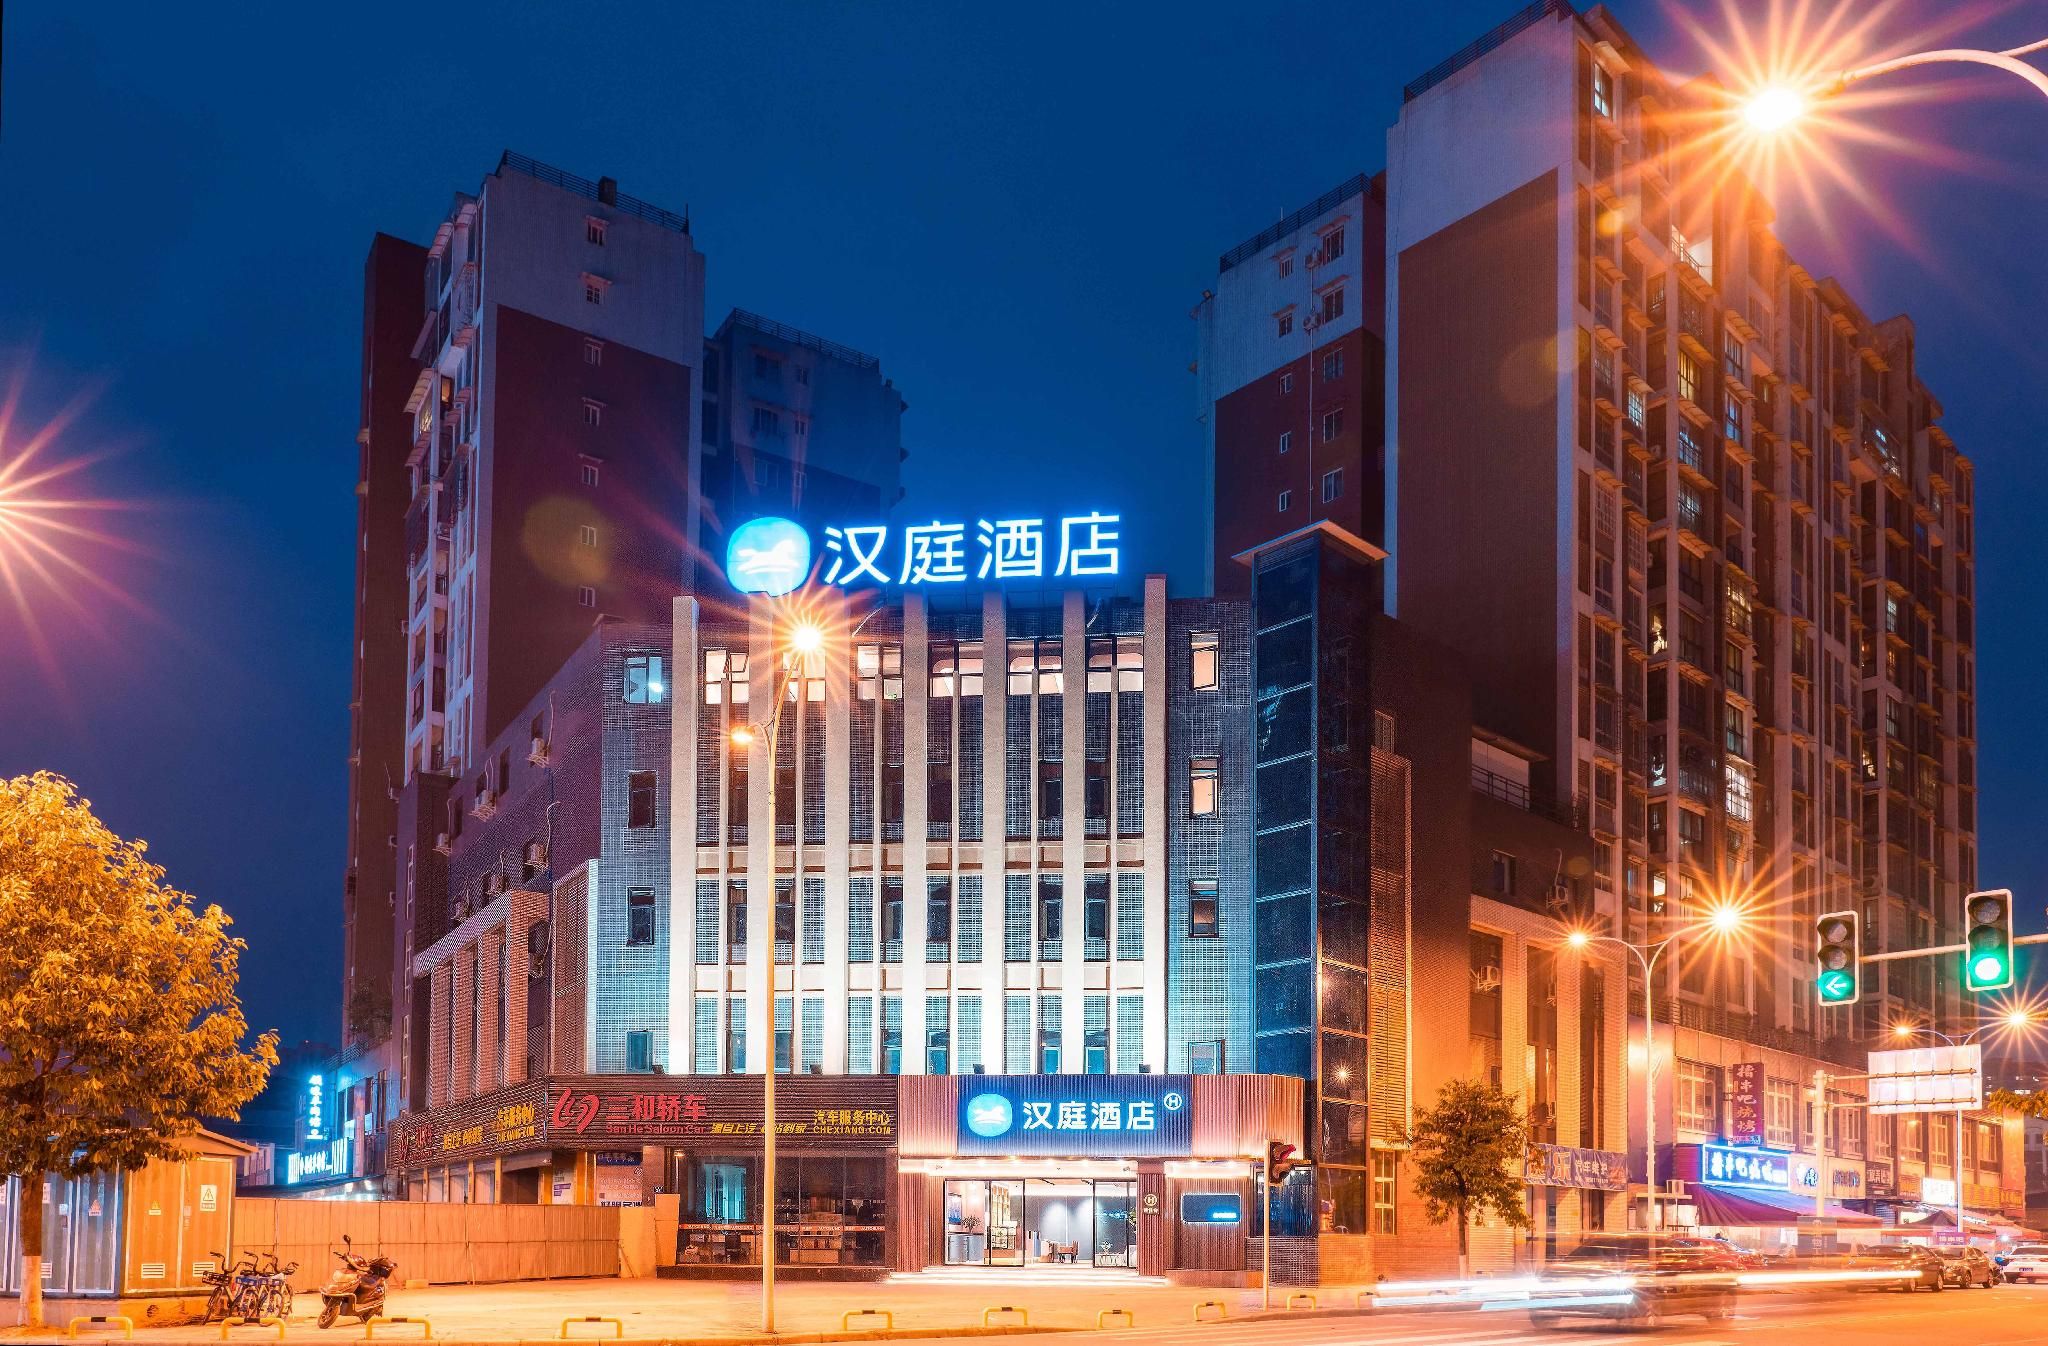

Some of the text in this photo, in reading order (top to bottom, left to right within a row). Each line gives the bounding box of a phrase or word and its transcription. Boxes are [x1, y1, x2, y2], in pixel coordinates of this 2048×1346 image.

[824, 511, 1121, 585] 汉庭酒店
[605, 1094, 707, 1121] 三和轿车
[814, 1109, 891, 1125] 汽车服务中心
[1022, 1101, 1155, 1130] 汉庭酒店
[605, 1124, 705, 1134] San He Saloon Car
